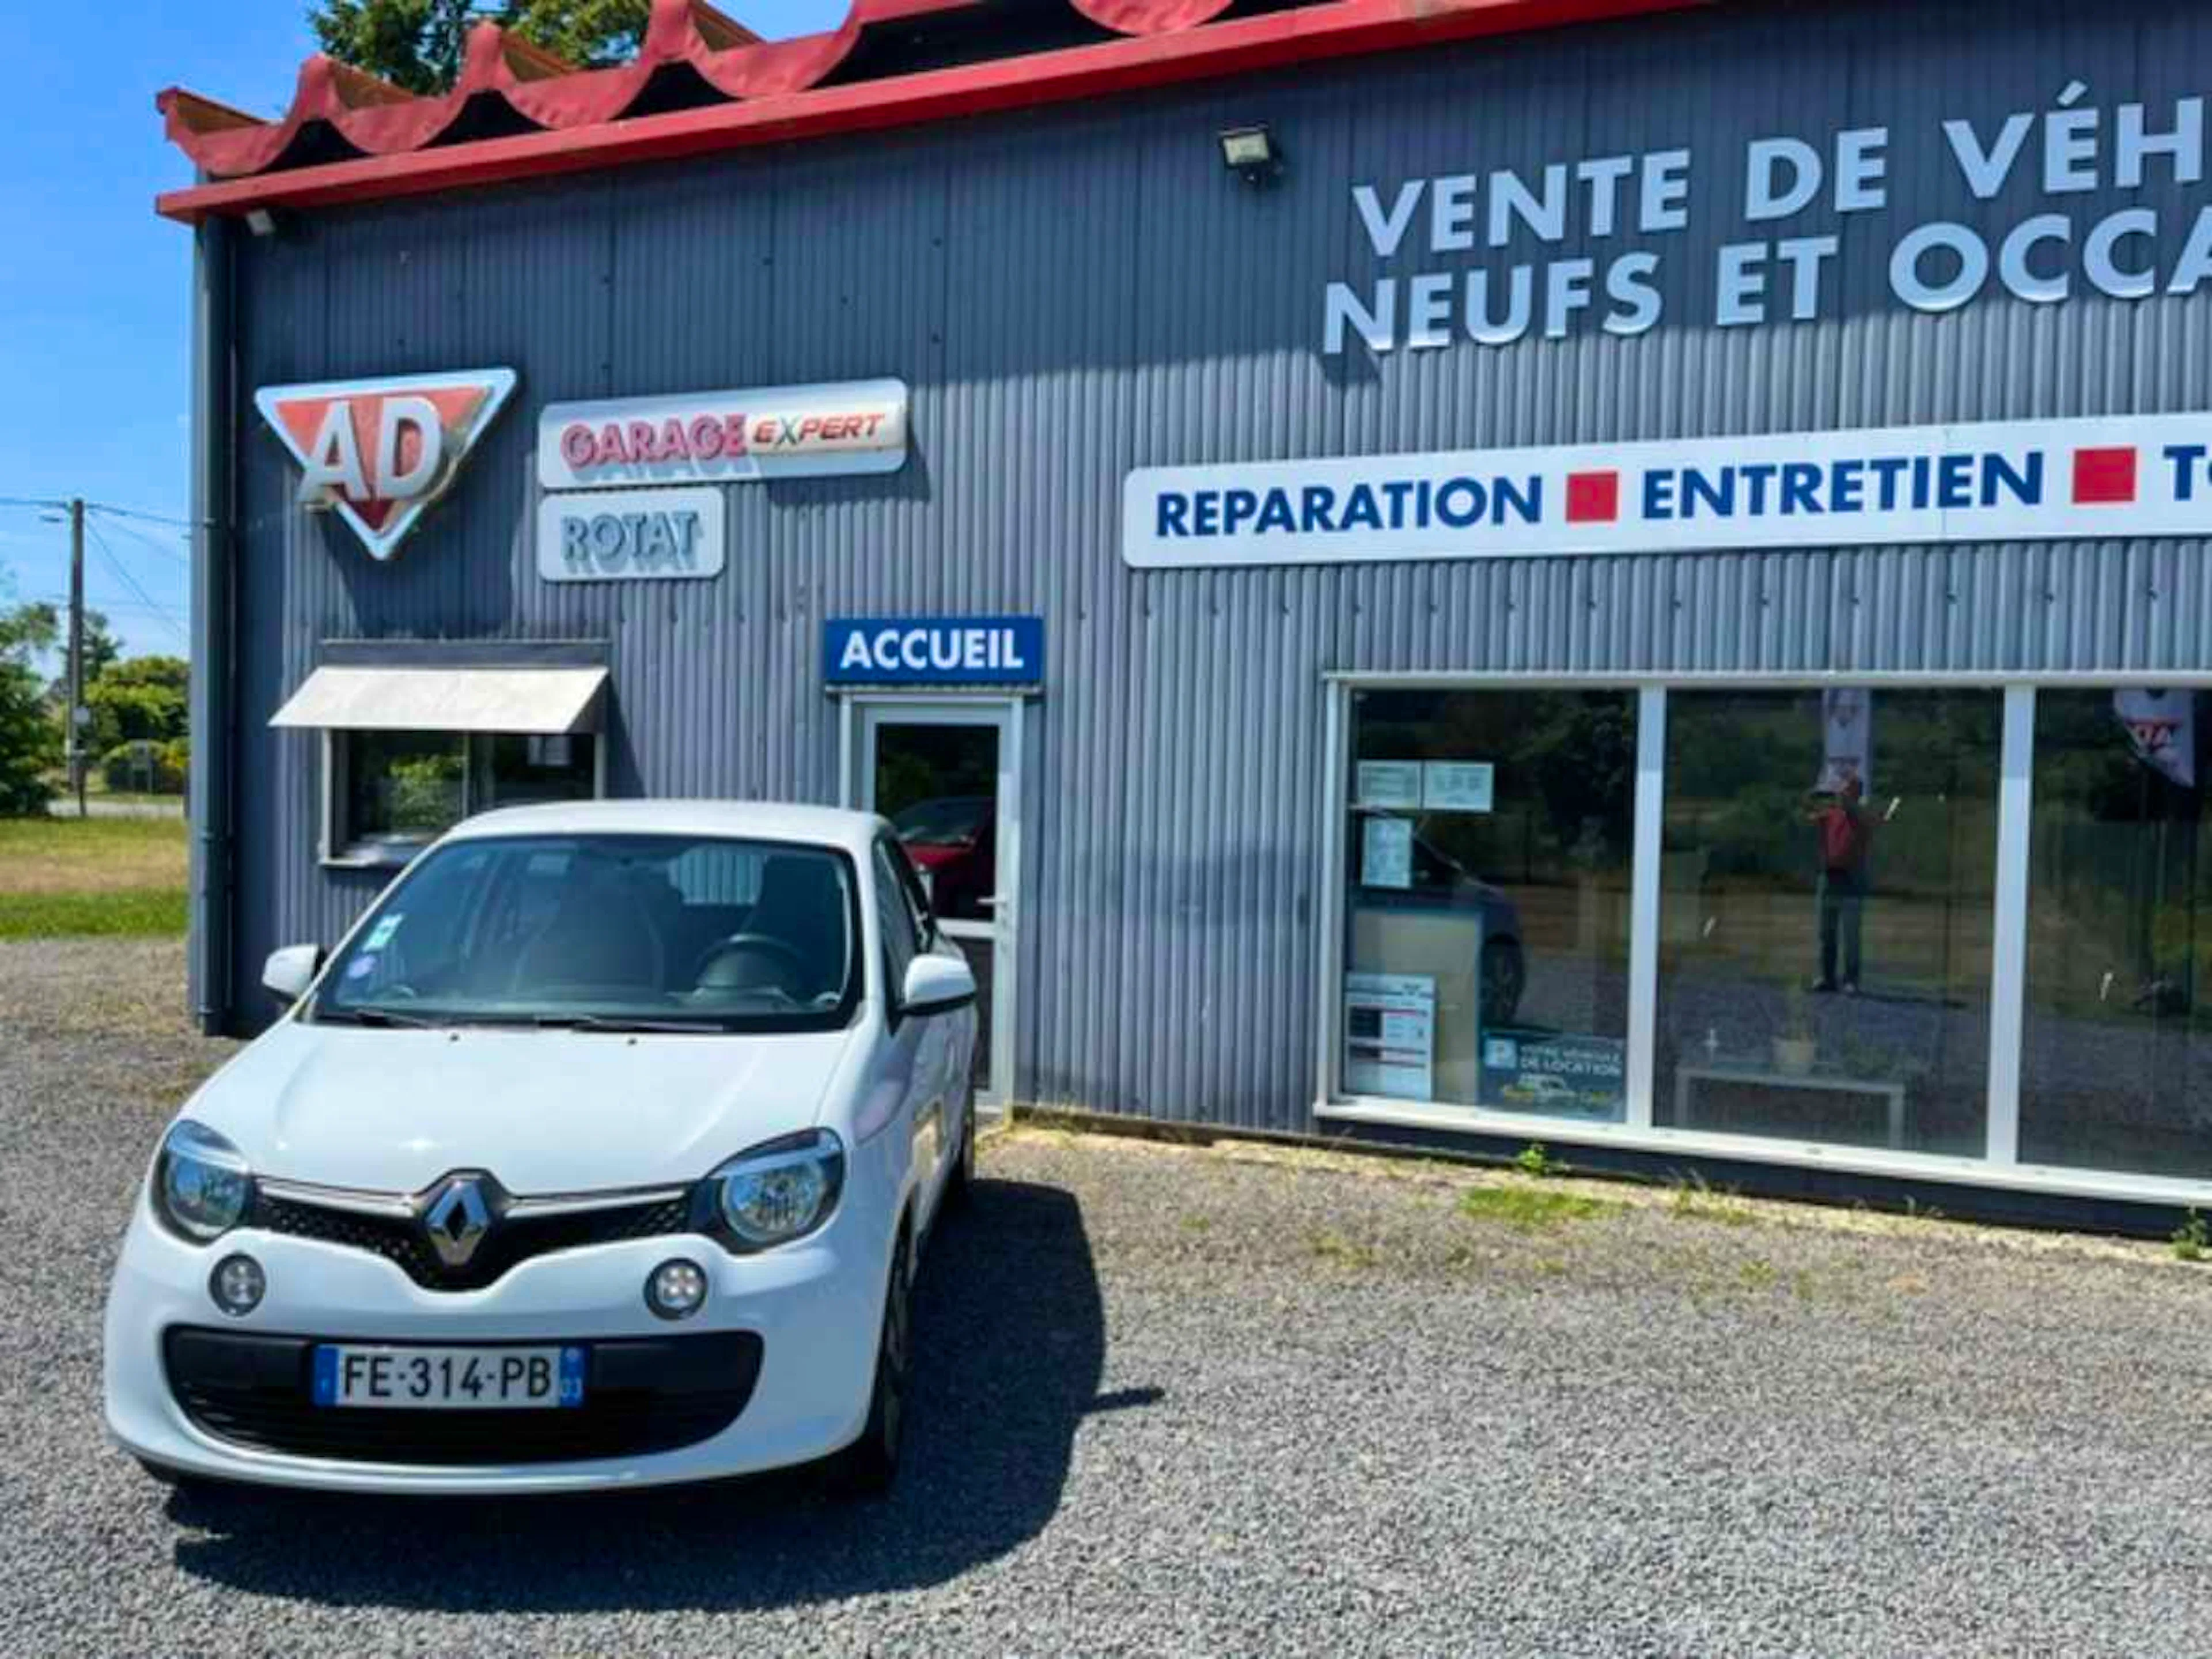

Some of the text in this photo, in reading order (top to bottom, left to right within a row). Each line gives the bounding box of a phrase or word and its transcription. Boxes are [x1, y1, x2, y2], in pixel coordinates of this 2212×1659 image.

[1352, 80, 2203, 257] VENTE DE VÉH
[1324, 250, 1662, 355] NEUFS
[1717, 235, 1839, 325] ET
[296, 395, 442, 503] AD
[560, 412, 750, 471] GARAGE
[1155, 444, 2212, 538] REPARATION ENTRETIEN T
[560, 509, 700, 562] ROTAT
[839, 628, 1025, 671] ACCUEIL
[344, 1355, 551, 1398] FE-314-PB
